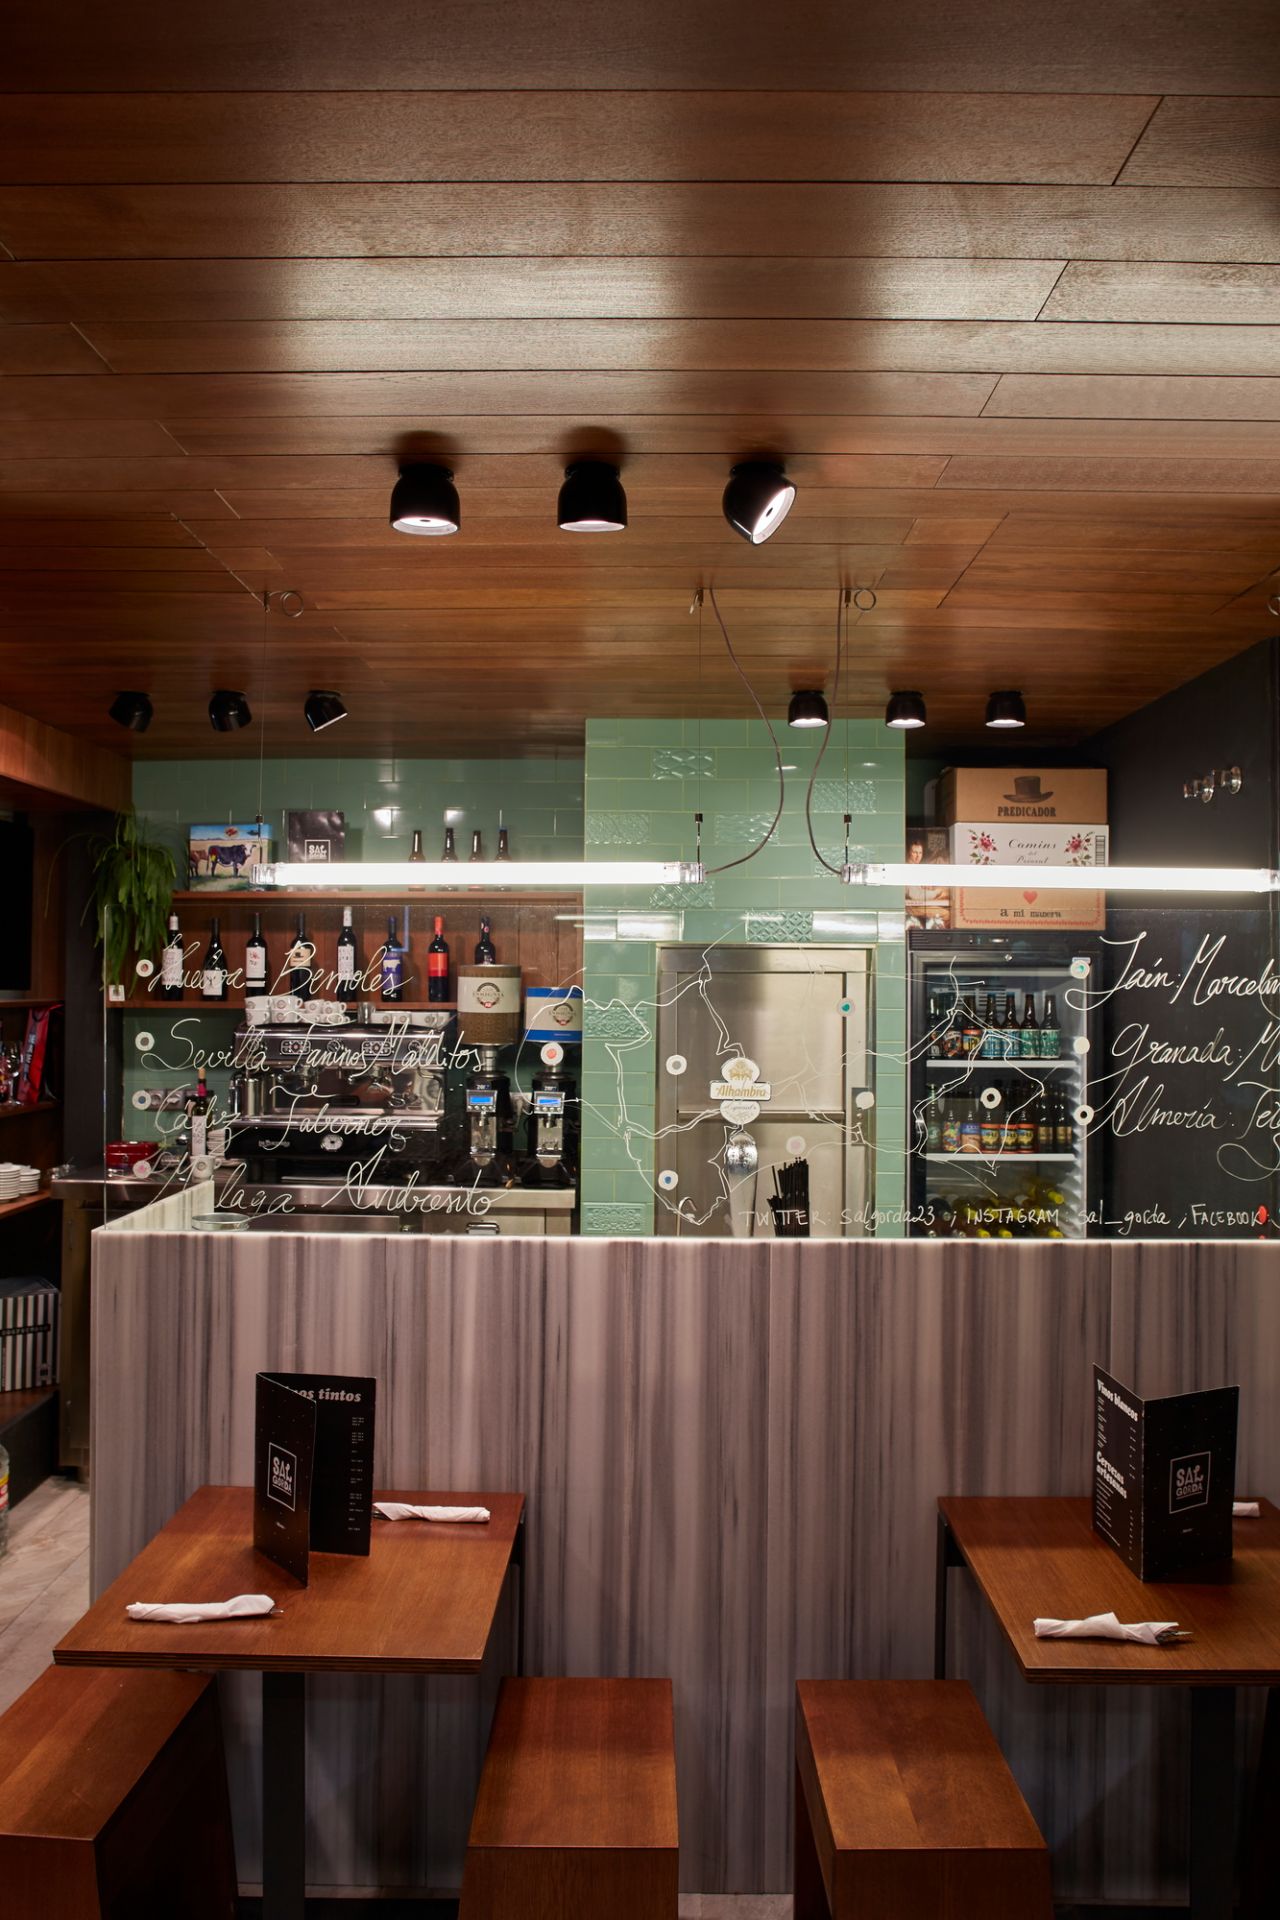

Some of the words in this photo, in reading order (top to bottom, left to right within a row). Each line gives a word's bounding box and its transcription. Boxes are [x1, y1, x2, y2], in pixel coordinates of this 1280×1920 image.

[997, 806, 1057, 818] PREDICADOR
[1000, 908, 1008, 917] a
[1013, 909, 1025, 918] mi
[349, 1016, 486, 1082] Malditos
[715, 1084, 767, 1098] Alhambra
[321, 1143, 511, 1217] Andresito
[318, 1388, 362, 1403] tintos
[1096, 1378, 1114, 1402] Vinos
[1114, 1393, 1138, 1422] blancos
[272, 1456, 293, 1484] SAL
[1096, 1450, 1125, 1485] Cervezas
[1176, 1464, 1205, 1488] SAL
